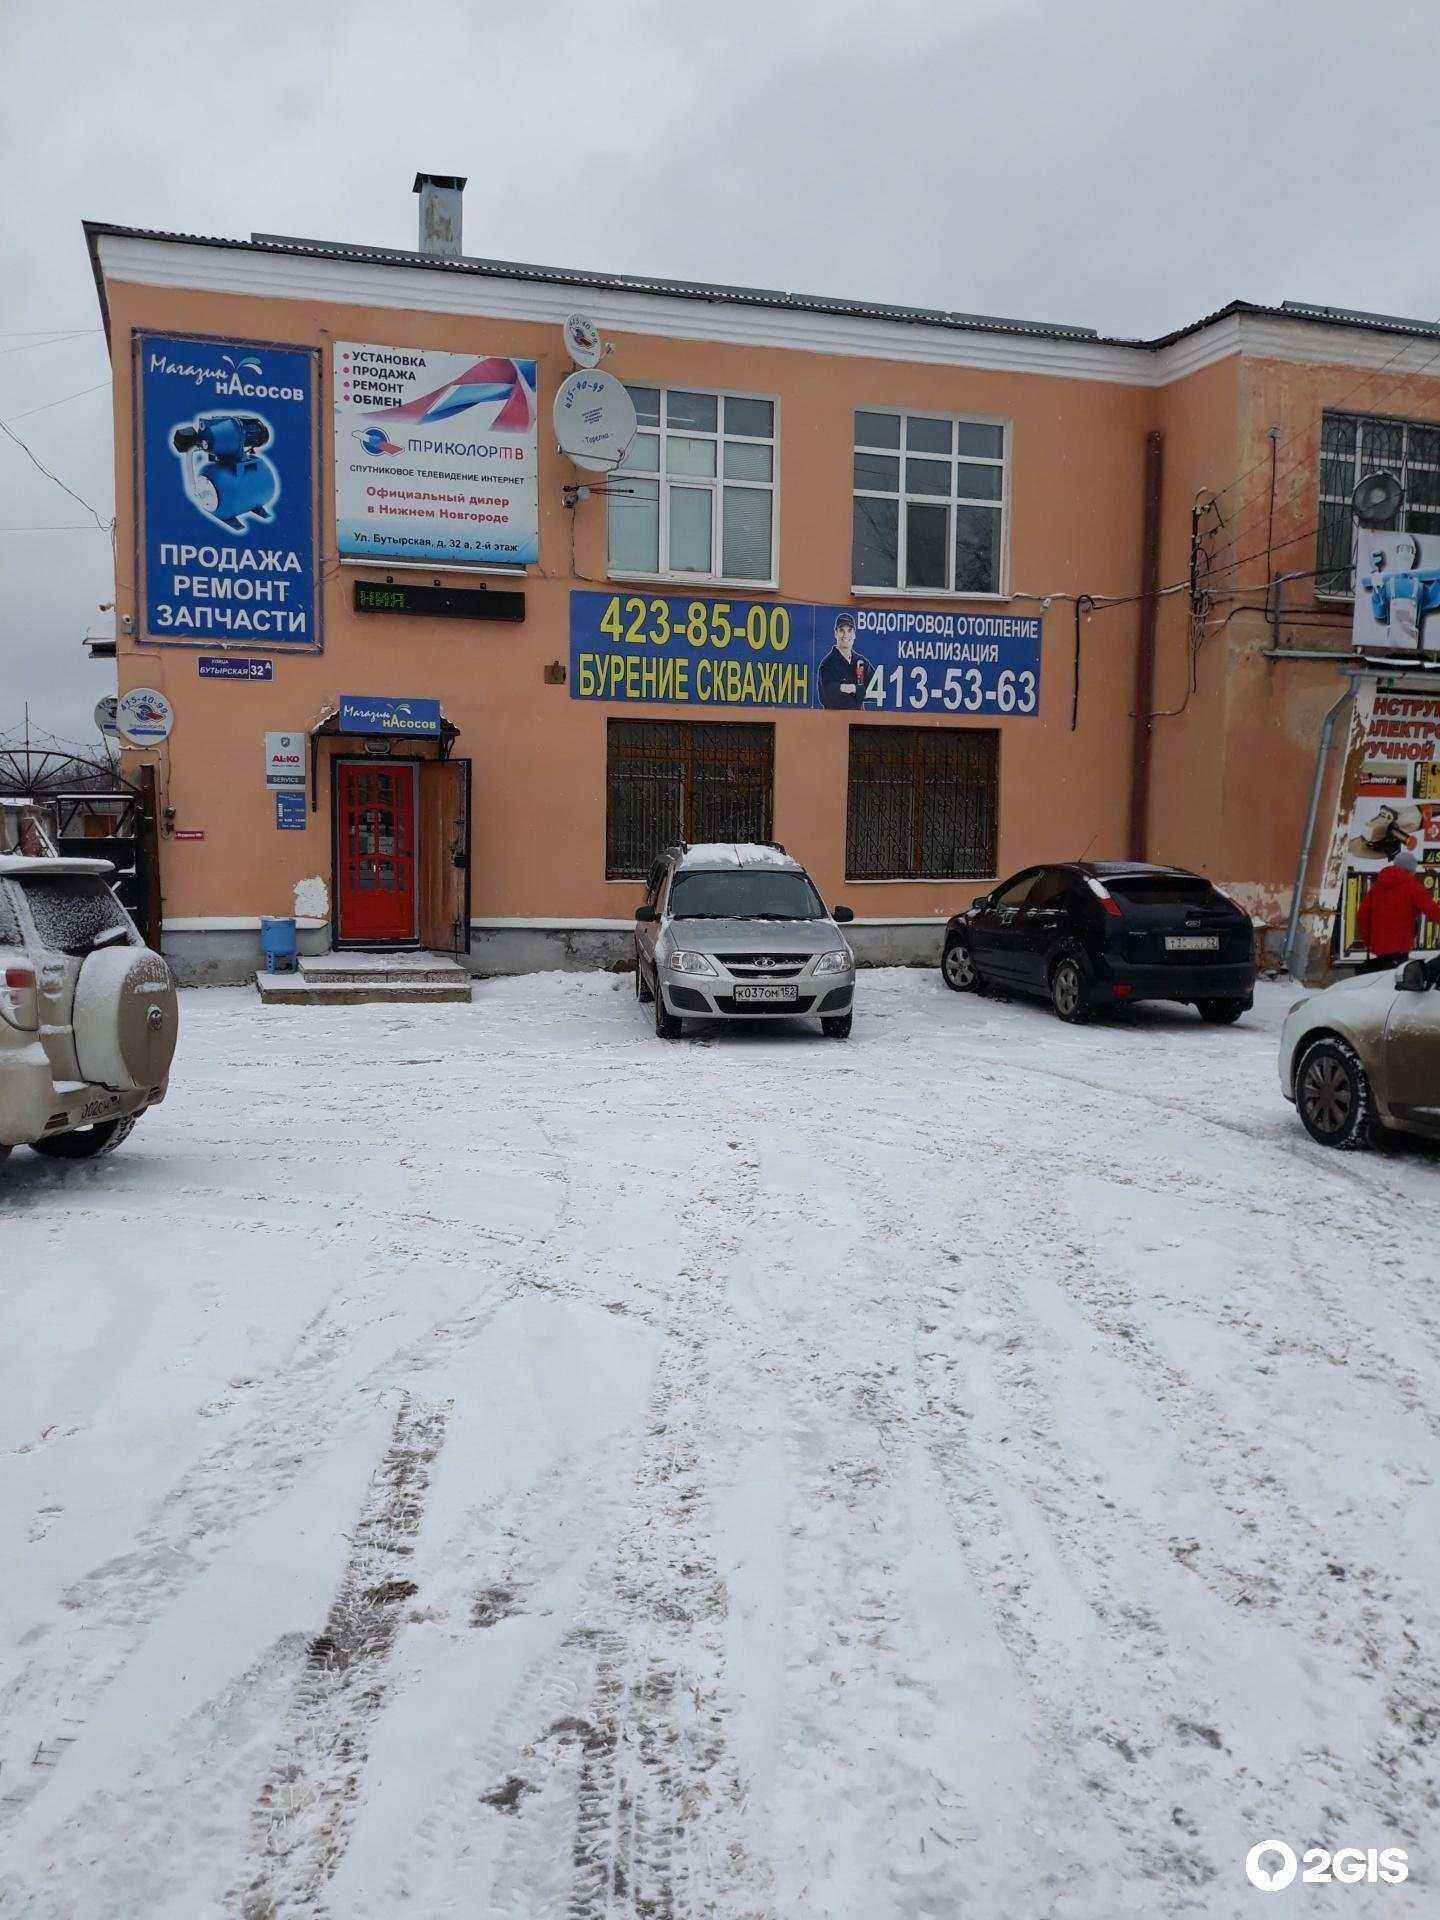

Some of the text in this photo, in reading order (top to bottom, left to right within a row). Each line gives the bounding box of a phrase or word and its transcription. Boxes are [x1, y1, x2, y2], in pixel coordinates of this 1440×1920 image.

[150, 354, 228, 385] Магазин
[352, 351, 426, 368] УСТАНОВКА
[352, 366, 416, 381] ПРОДАЖА
[353, 380, 404, 393] РЕМОНТ
[352, 394, 402, 407] ОБМЕН
[349, 464, 524, 485] СПУТНИКОВОЕ ТЕЛЕВИДЕНИЕ ИНТЕРНЕТ
[366, 486, 510, 507] Официальный дилер
[379, 505, 435, 518] Нижнем
[439, 509, 509, 523] Новгороде
[354, 533, 370, 542] Ул.
[373, 534, 433, 548] Бутырская,
[449, 539, 461, 549] 32
[475, 541, 491, 550] 2-й
[159, 543, 303, 573] ПРОДАЖА
[173, 574, 290, 602] РЕМОНТ
[156, 604, 306, 633] ЗАПЧАСТИ
[600, 596, 790, 651] 423-85-00
[857, 611, 1040, 639] ВОДОПРОВОД ОТОПЛЕНИЕ
[897, 640, 999, 665] КАНАЛИЗАЦИЯ
[199, 666, 248, 676] БУТЫРСКАЯ
[579, 653, 808, 704] БУРЕНИЕ СКВАЖИН
[865, 664, 1036, 713] 413-53-63
[343, 704, 391, 724] Магазин
